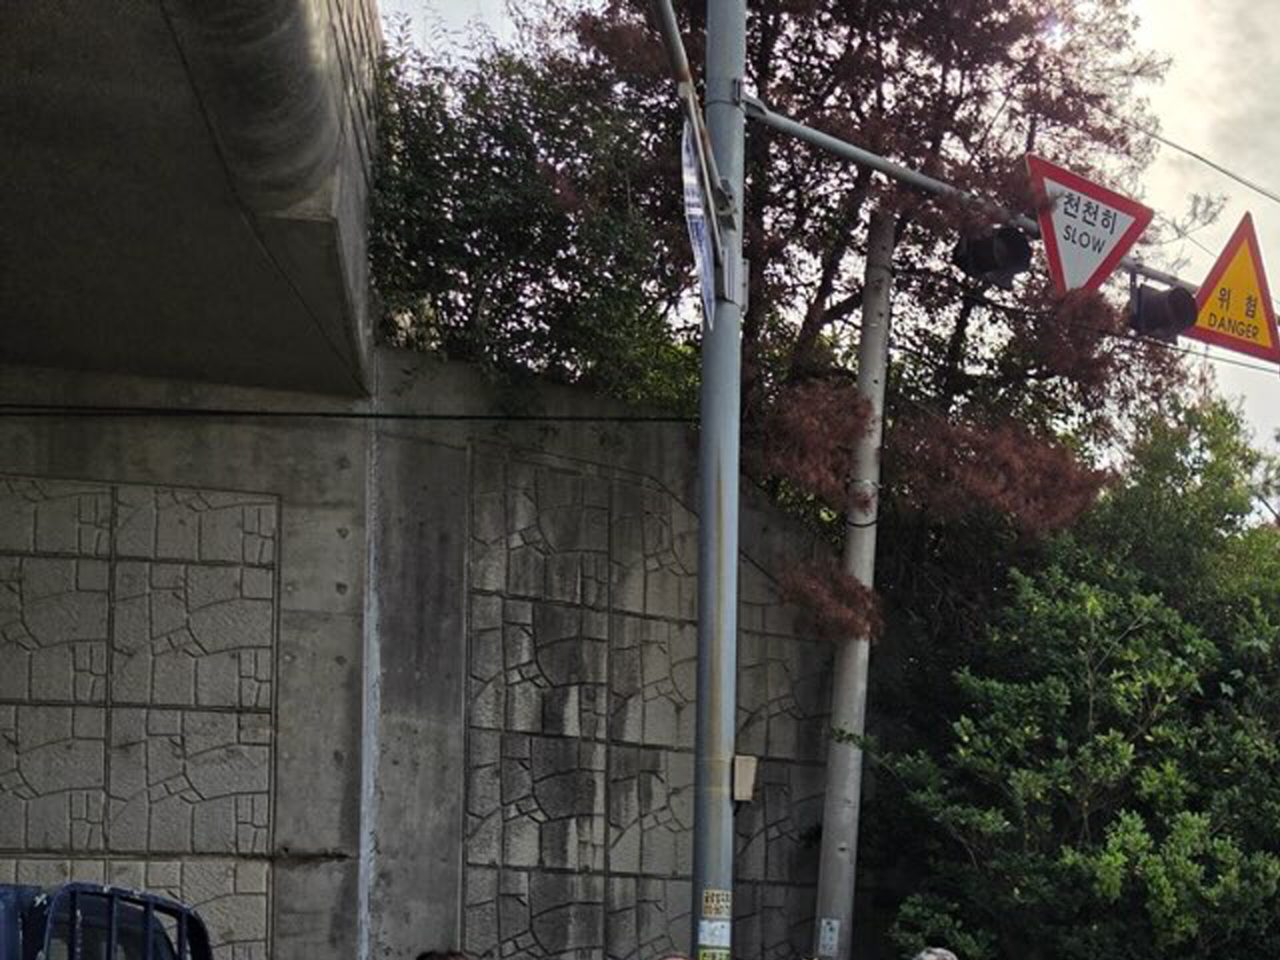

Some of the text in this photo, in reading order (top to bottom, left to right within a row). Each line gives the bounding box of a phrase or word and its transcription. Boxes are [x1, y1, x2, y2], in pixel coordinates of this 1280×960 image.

[1062, 191, 1118, 234] 천천히
[1062, 224, 1106, 254] SLOW
[1208, 312, 1260, 340] DANGER
